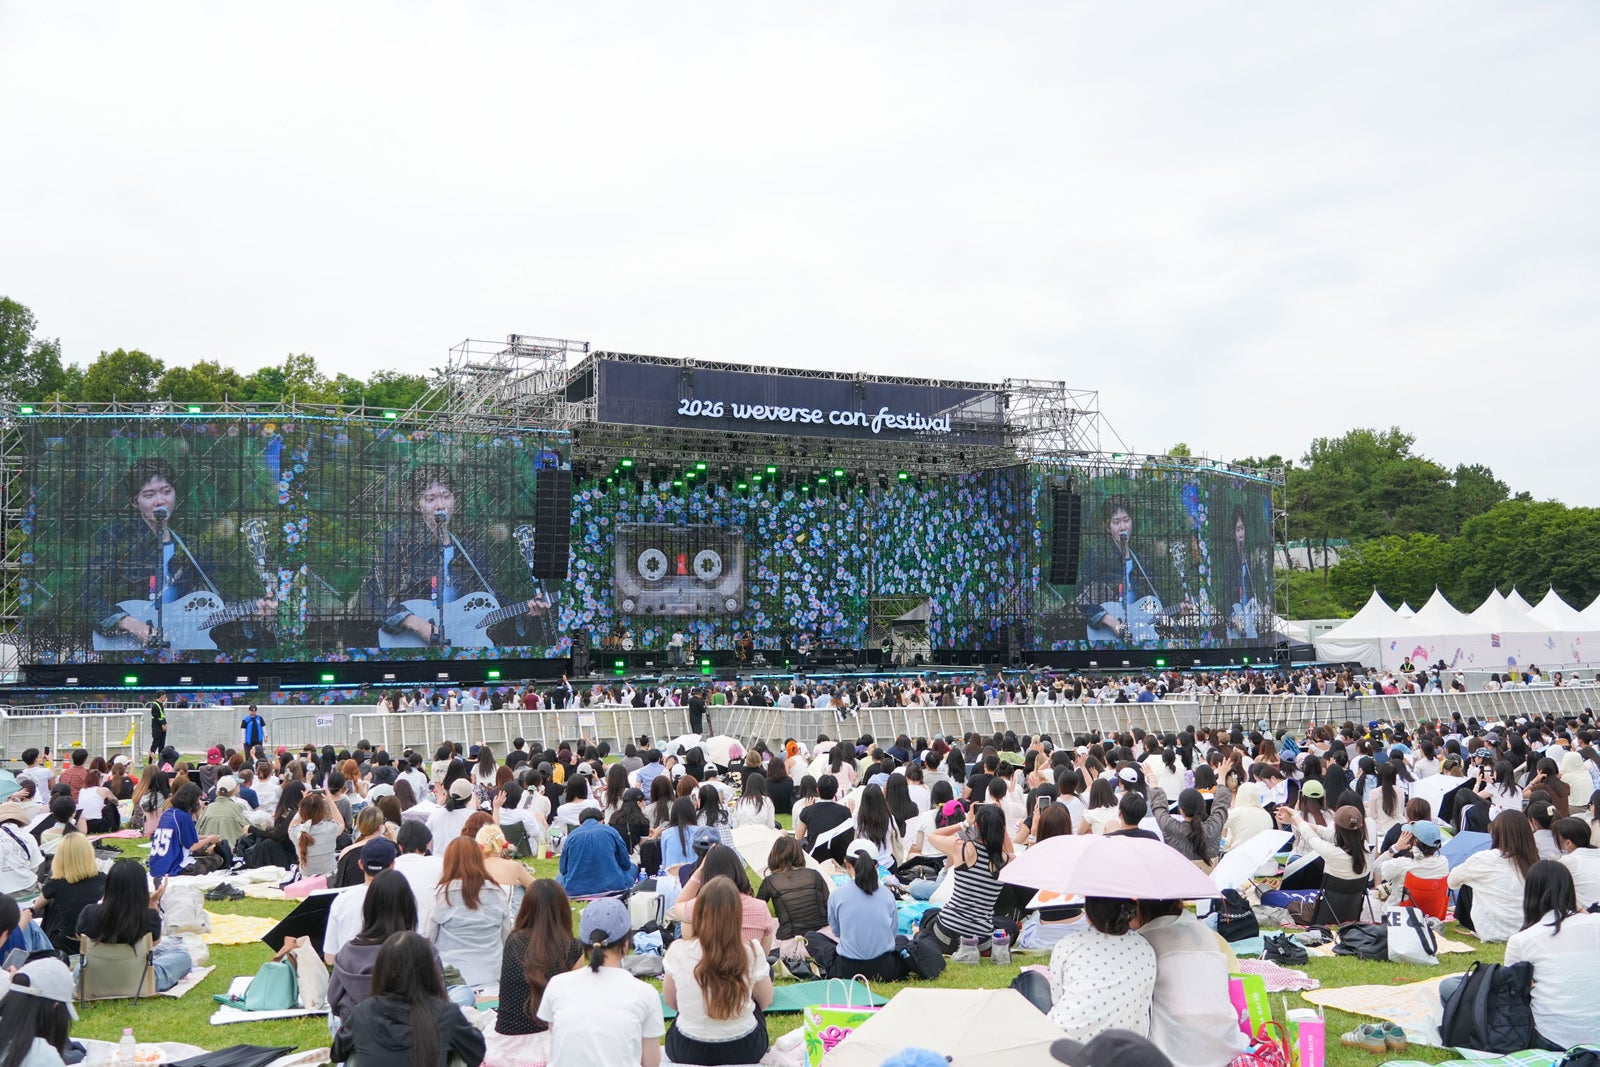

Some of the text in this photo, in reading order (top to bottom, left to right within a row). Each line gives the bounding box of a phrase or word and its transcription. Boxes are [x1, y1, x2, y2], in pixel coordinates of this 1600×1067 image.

[677, 399, 952, 434] 2026 weverse con festival
[150, 828, 174, 857] 35
[1253, 992, 1264, 1015] OLIVE
